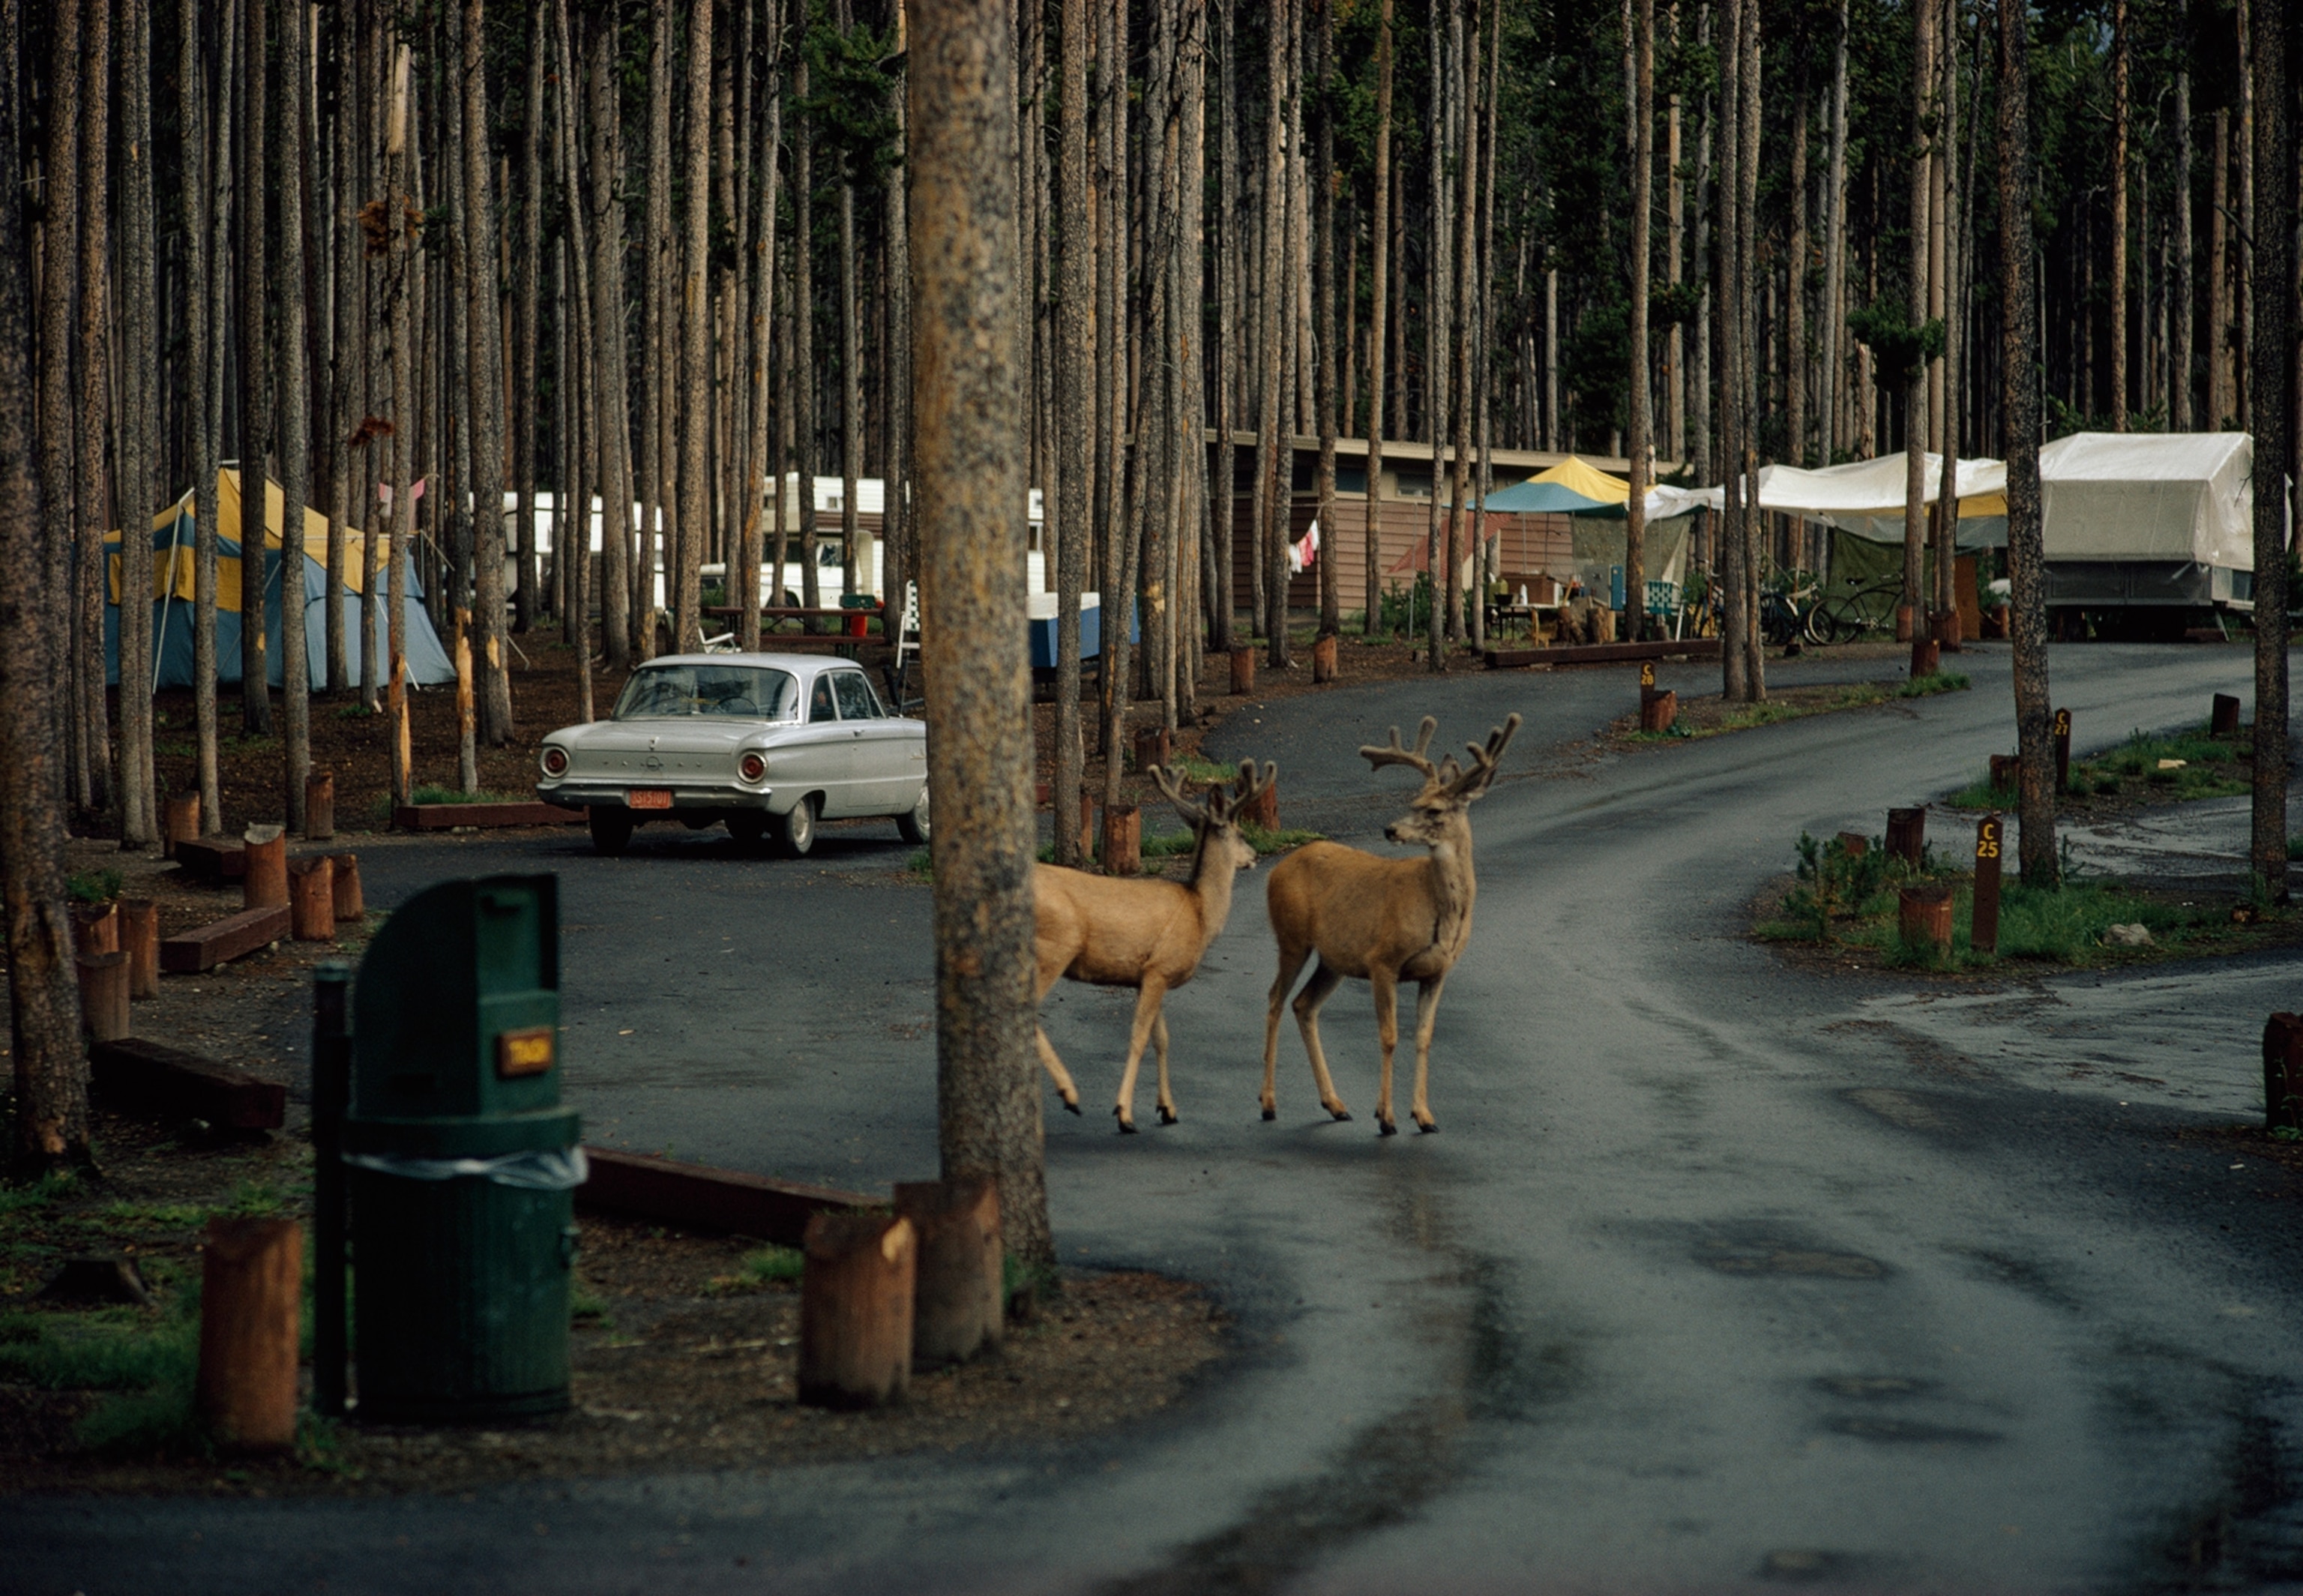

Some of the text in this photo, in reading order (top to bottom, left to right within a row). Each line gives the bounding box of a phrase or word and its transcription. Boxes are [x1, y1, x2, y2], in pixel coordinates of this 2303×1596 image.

[1643, 664, 1651, 675] C
[1641, 674, 1654, 685] 28
[2059, 712, 2065, 724] C
[2055, 723, 2068, 735] 27
[1984, 823, 1994, 840] C
[1978, 840, 1999, 858] 25
